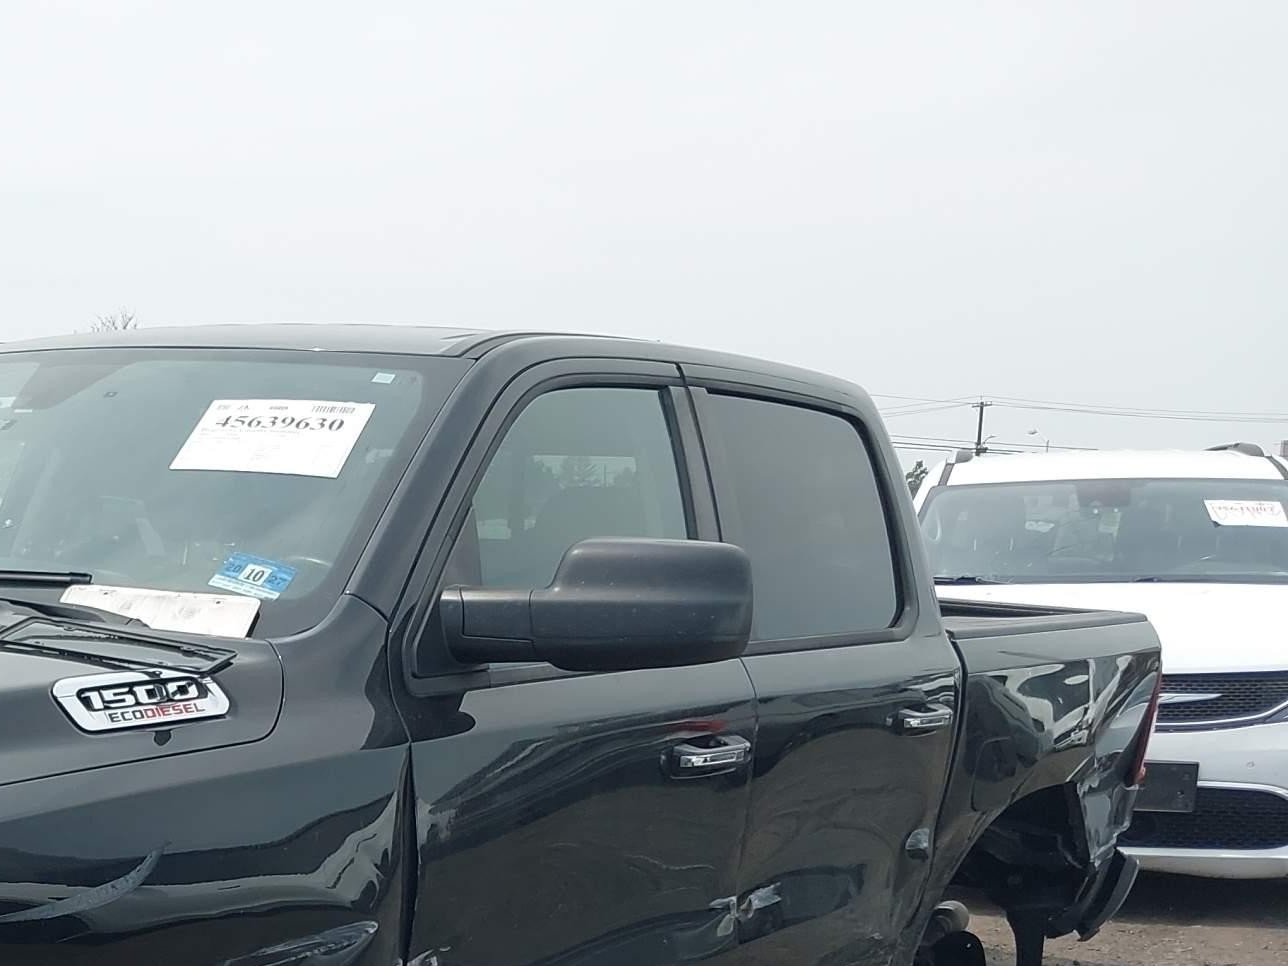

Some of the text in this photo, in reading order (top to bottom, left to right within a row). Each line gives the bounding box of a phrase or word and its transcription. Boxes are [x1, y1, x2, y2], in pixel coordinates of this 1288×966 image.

[216, 415, 344, 432] 45639630
[244, 568, 265, 582] 10
[81, 679, 200, 712] 1500
[108, 702, 206, 723] ECODIESEL
